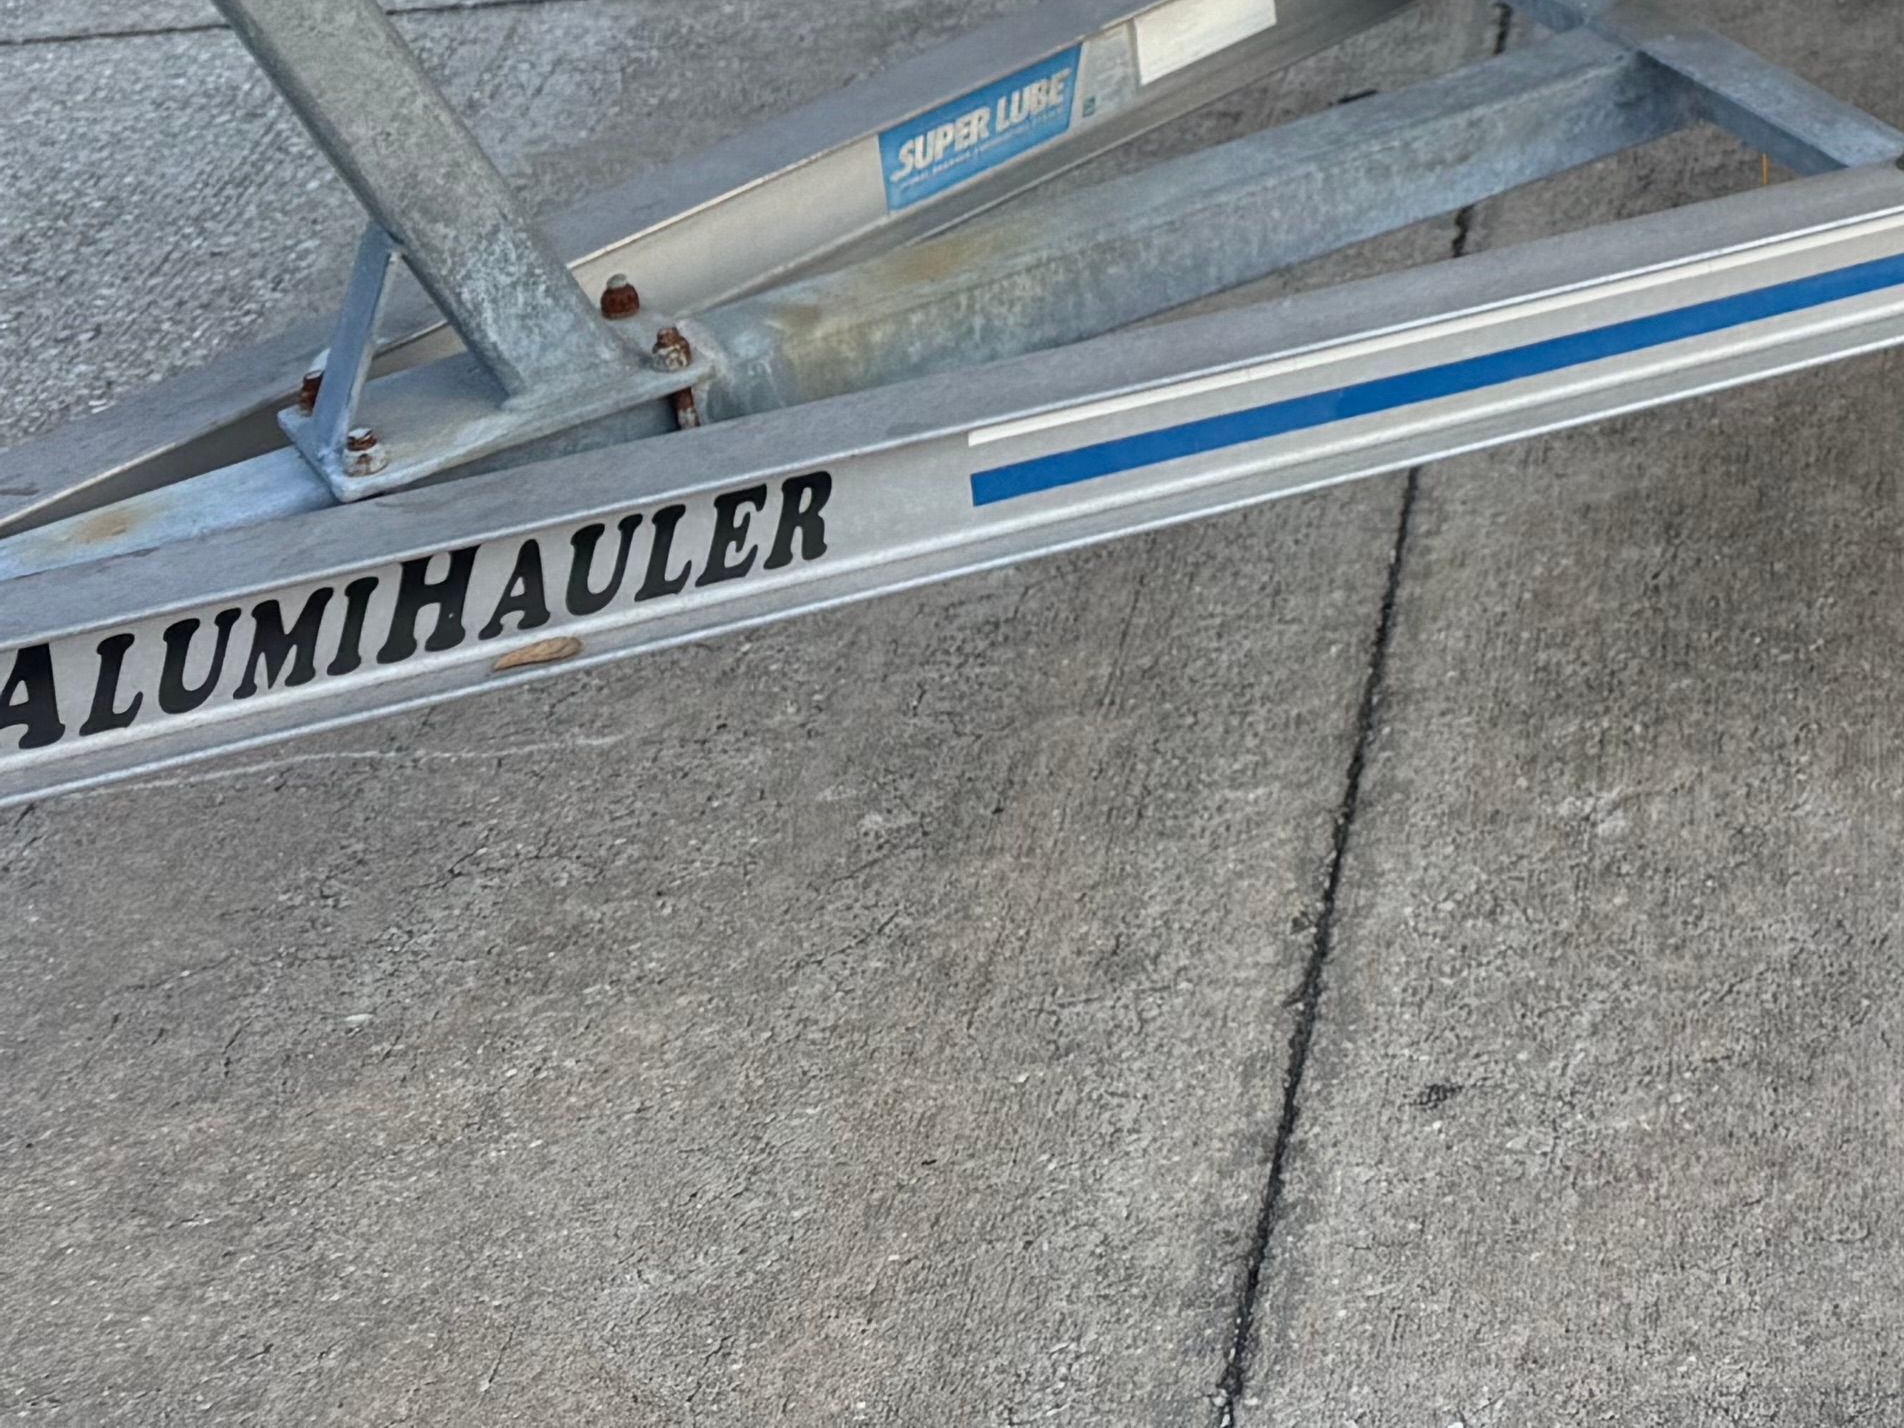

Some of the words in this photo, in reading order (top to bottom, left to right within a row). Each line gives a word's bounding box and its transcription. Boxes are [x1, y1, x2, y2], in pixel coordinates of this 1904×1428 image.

[890, 105, 992, 182] SUPER
[995, 66, 1073, 123] LUBE
[0, 469, 833, 750] ALUMIHAULER
